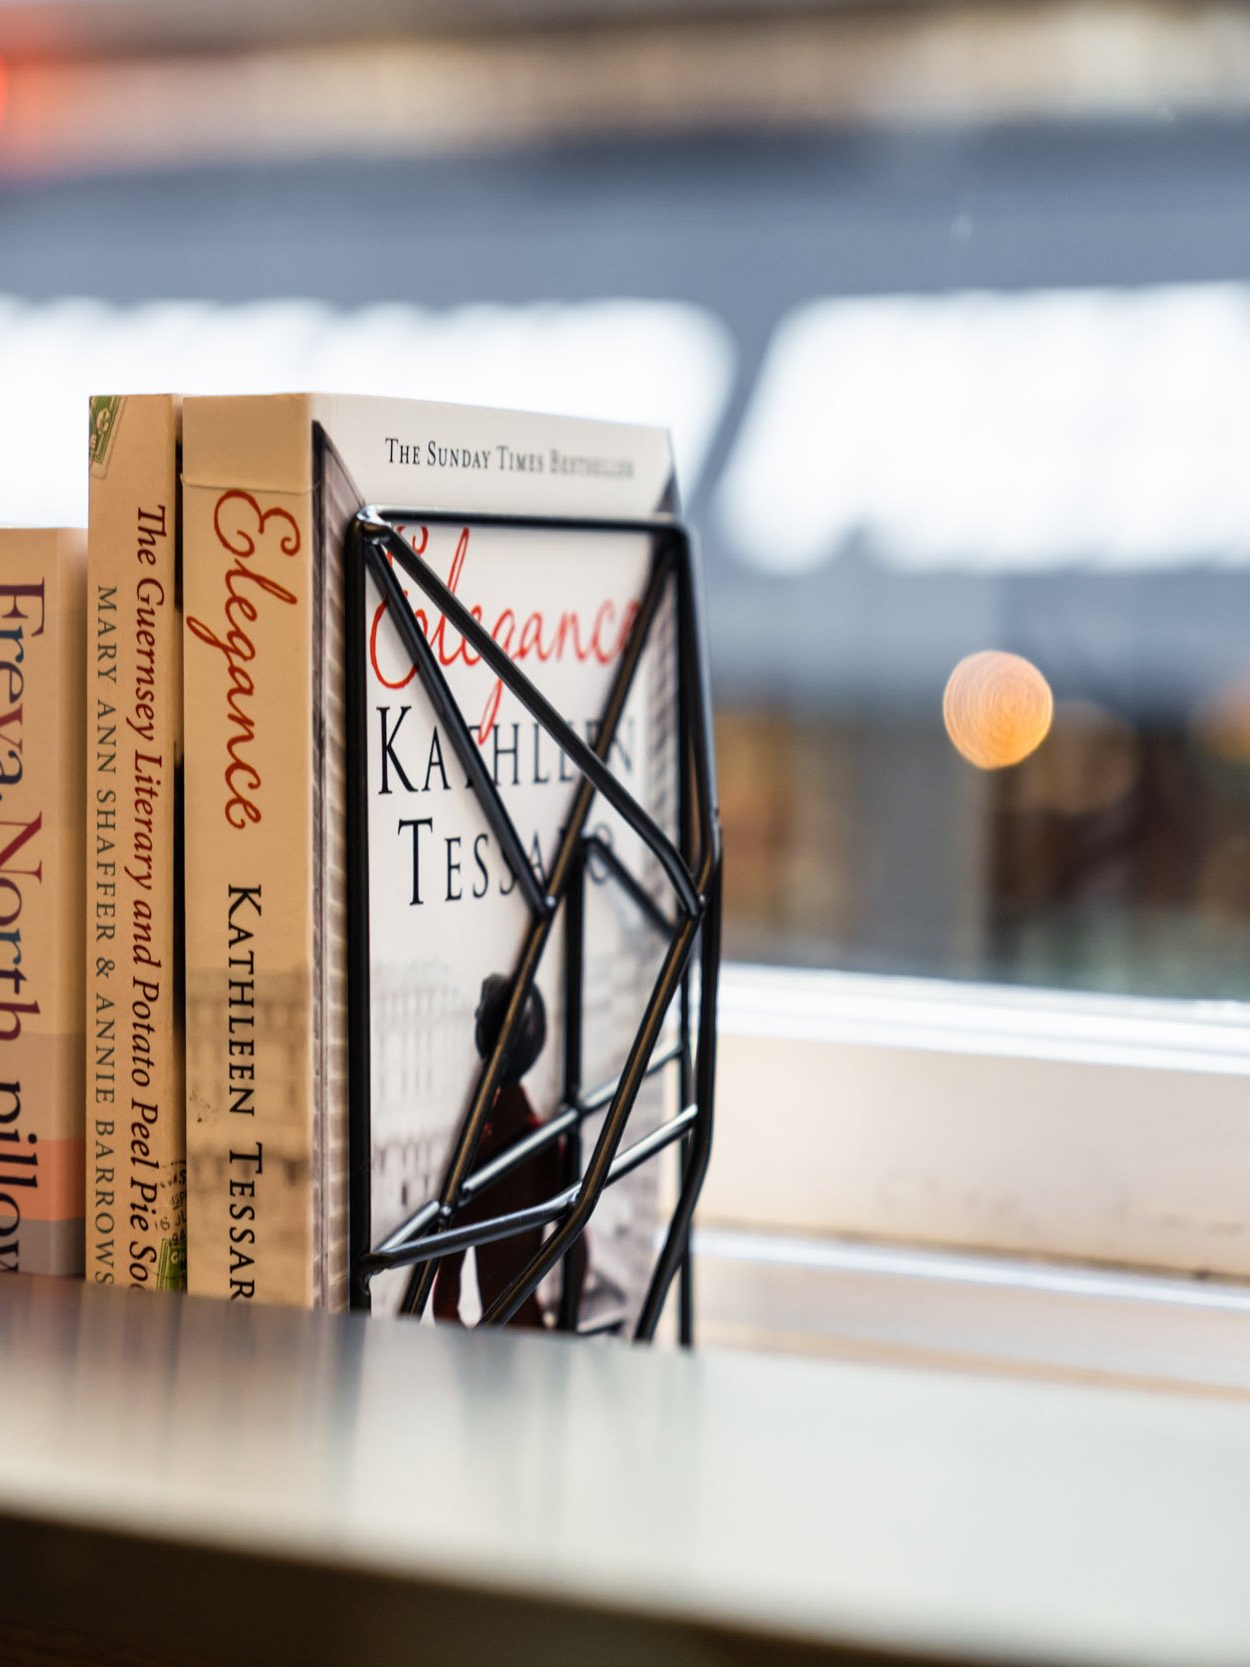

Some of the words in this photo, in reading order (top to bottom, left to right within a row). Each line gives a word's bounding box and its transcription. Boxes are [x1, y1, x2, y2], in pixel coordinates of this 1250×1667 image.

[385, 438, 420, 466] THE
[427, 441, 491, 470] SUNDAY
[496, 446, 543, 474] TIMES
[137, 504, 167, 565] The
[97, 585, 117, 684] MARY
[126, 577, 165, 742] Guernsey
[186, 488, 301, 830] Elegance
[96, 699, 117, 775] ANN
[376, 706, 635, 795] KAHLEN
[95, 789, 117, 941] SHAFFER
[124, 749, 163, 890] Literary
[398, 817, 615, 906] TESSAO
[95, 957, 116, 979] &
[132, 900, 162, 968] and
[131, 976, 160, 1087] Potato
[228, 884, 262, 1117] KATHLEEN
[95, 992, 116, 1104] ANNIE
[130, 1097, 159, 1169] Peel
[94, 1119, 116, 1284] BARROWS
[130, 1176, 157, 1232] Pie
